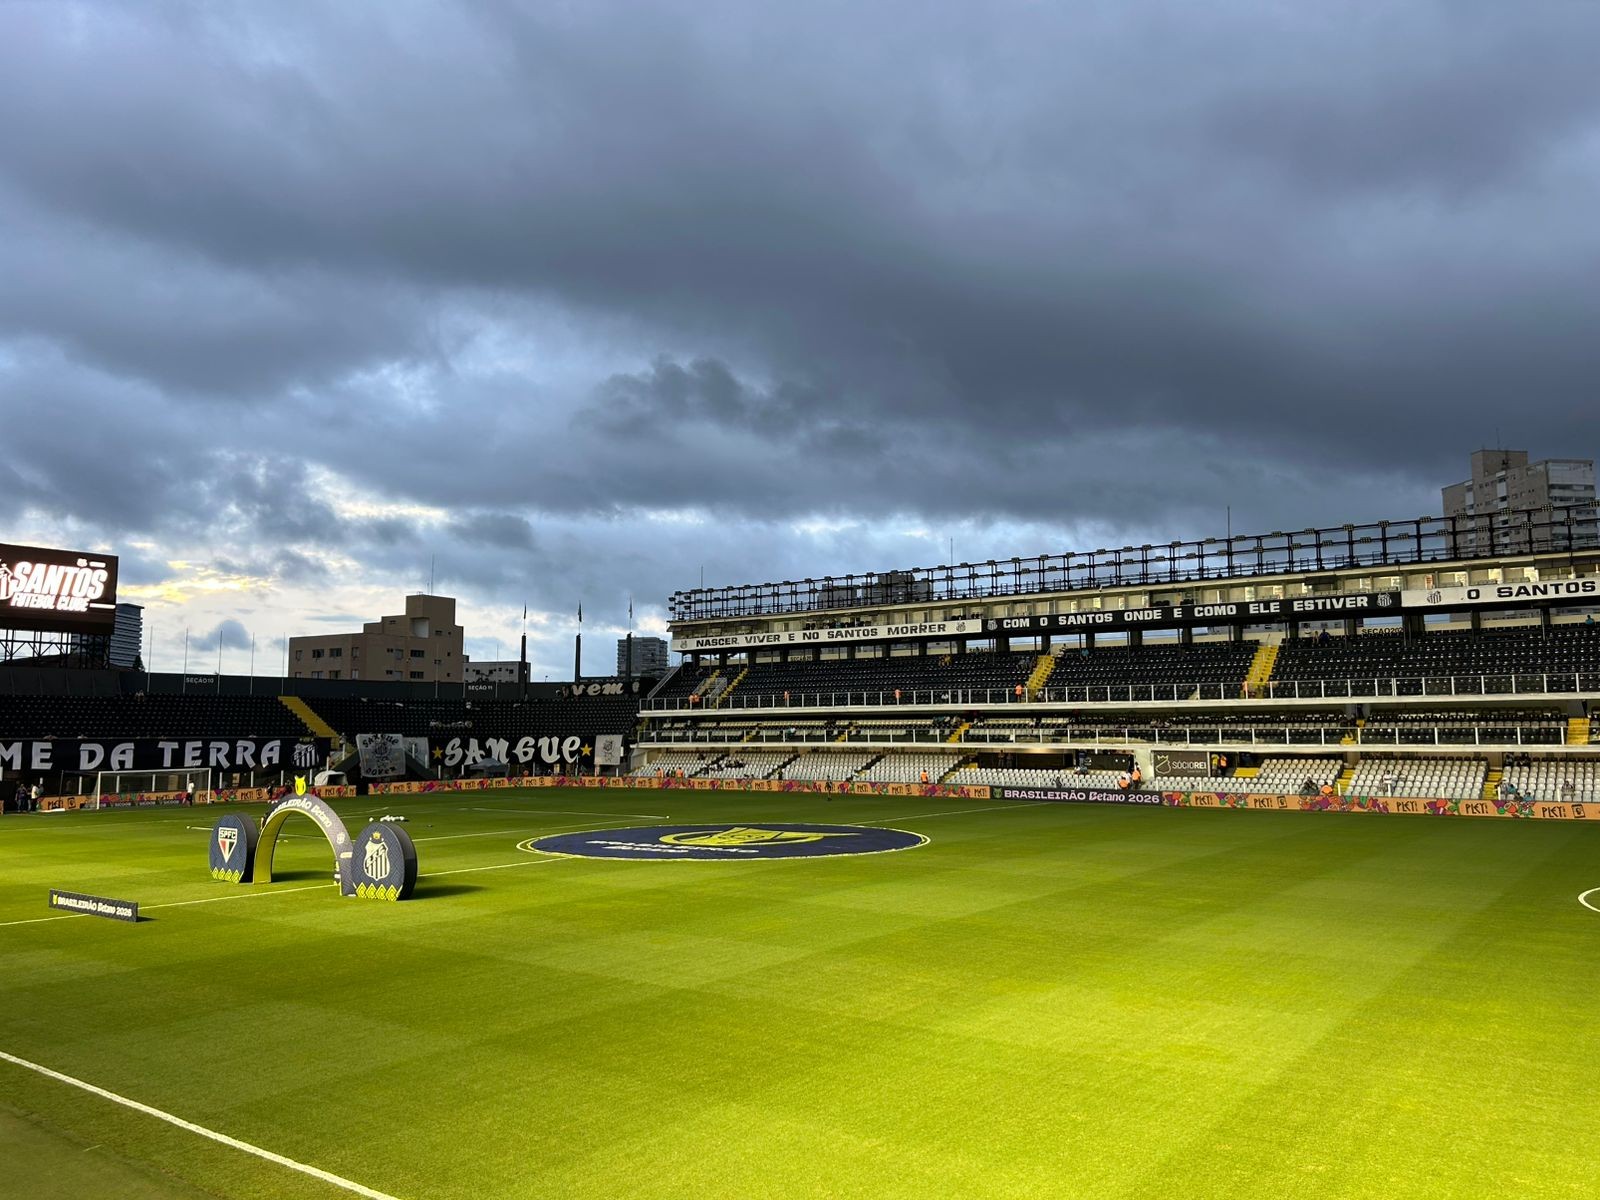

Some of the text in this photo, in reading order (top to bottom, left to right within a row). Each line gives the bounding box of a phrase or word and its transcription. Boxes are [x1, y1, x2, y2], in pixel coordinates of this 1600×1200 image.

[12, 560, 108, 600] SANTOS
[1467, 580, 1596, 600] O SANTOS
[10, 592, 90, 612] FUTEBOL CLUBE
[1003, 596, 1368, 629] COM O SANTOS ONDE E COMO ELE ESTIVER
[745, 634, 781, 644] VIVER
[788, 633, 795, 641] E
[802, 631, 819, 641] NO
[827, 627, 878, 640] SANTOS
[887, 622, 946, 636] MORRER
[80, 742, 135, 771] DA
[157, 739, 281, 769] TERRA
[1004, 788, 1160, 803] BRASILEIRÃO Betano 2026
[57, 896, 97, 911] BRASILEIRÃO
[116, 906, 133, 917] 2026
